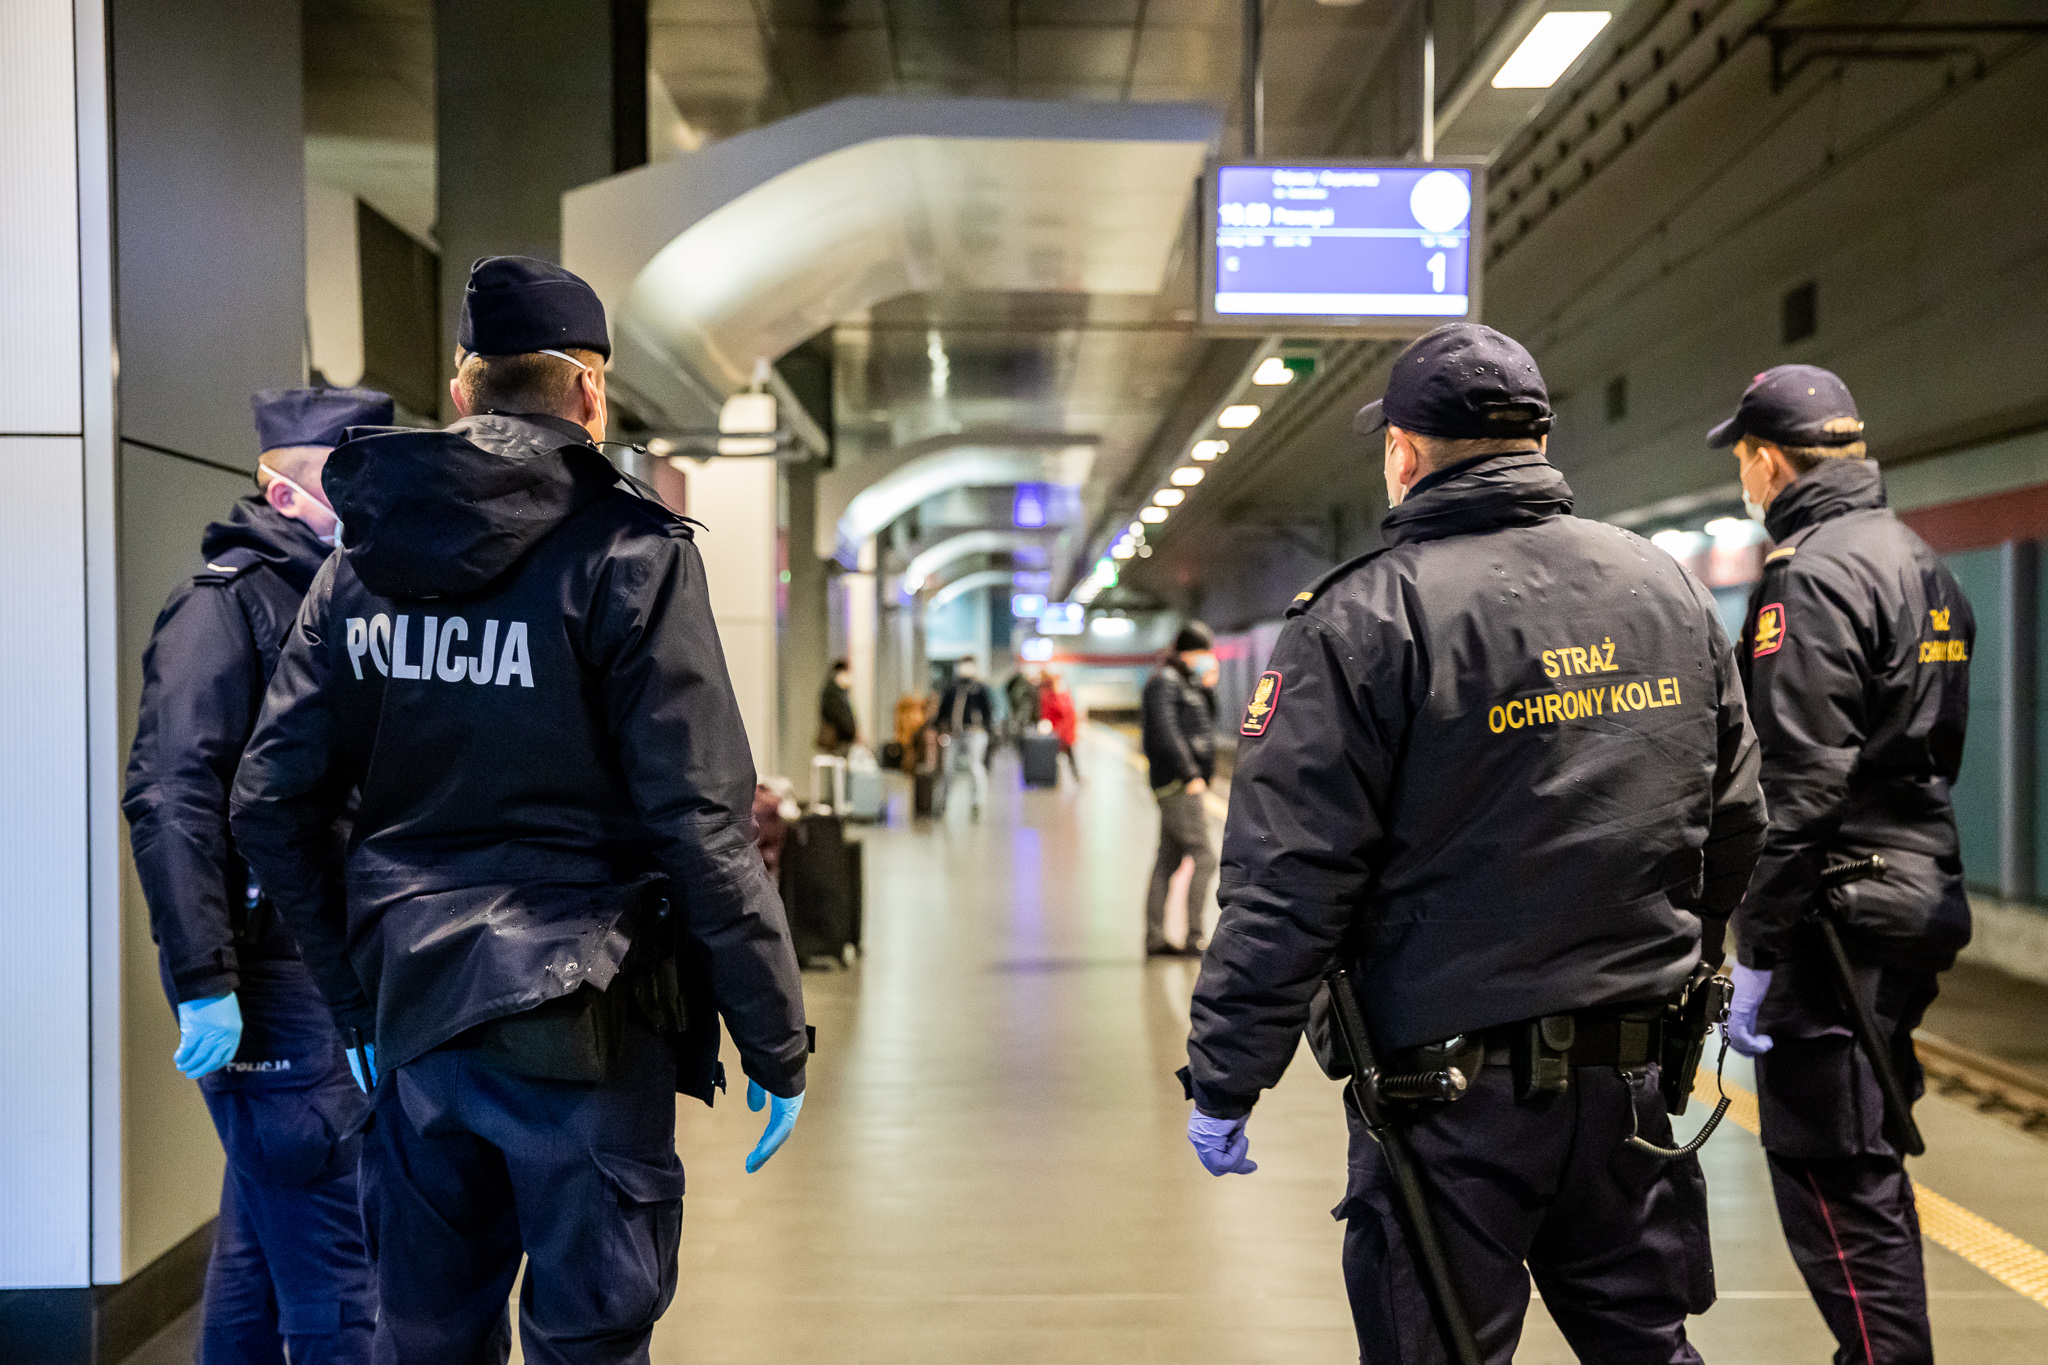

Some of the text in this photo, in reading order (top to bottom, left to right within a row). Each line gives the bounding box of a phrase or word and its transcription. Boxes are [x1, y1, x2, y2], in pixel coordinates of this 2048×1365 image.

[1426, 252, 1446, 293] 1
[346, 613, 534, 687] POLICJA
[1542, 637, 1619, 678] STRAŻ
[1488, 677, 1682, 734] OCHRONY KOLEI
